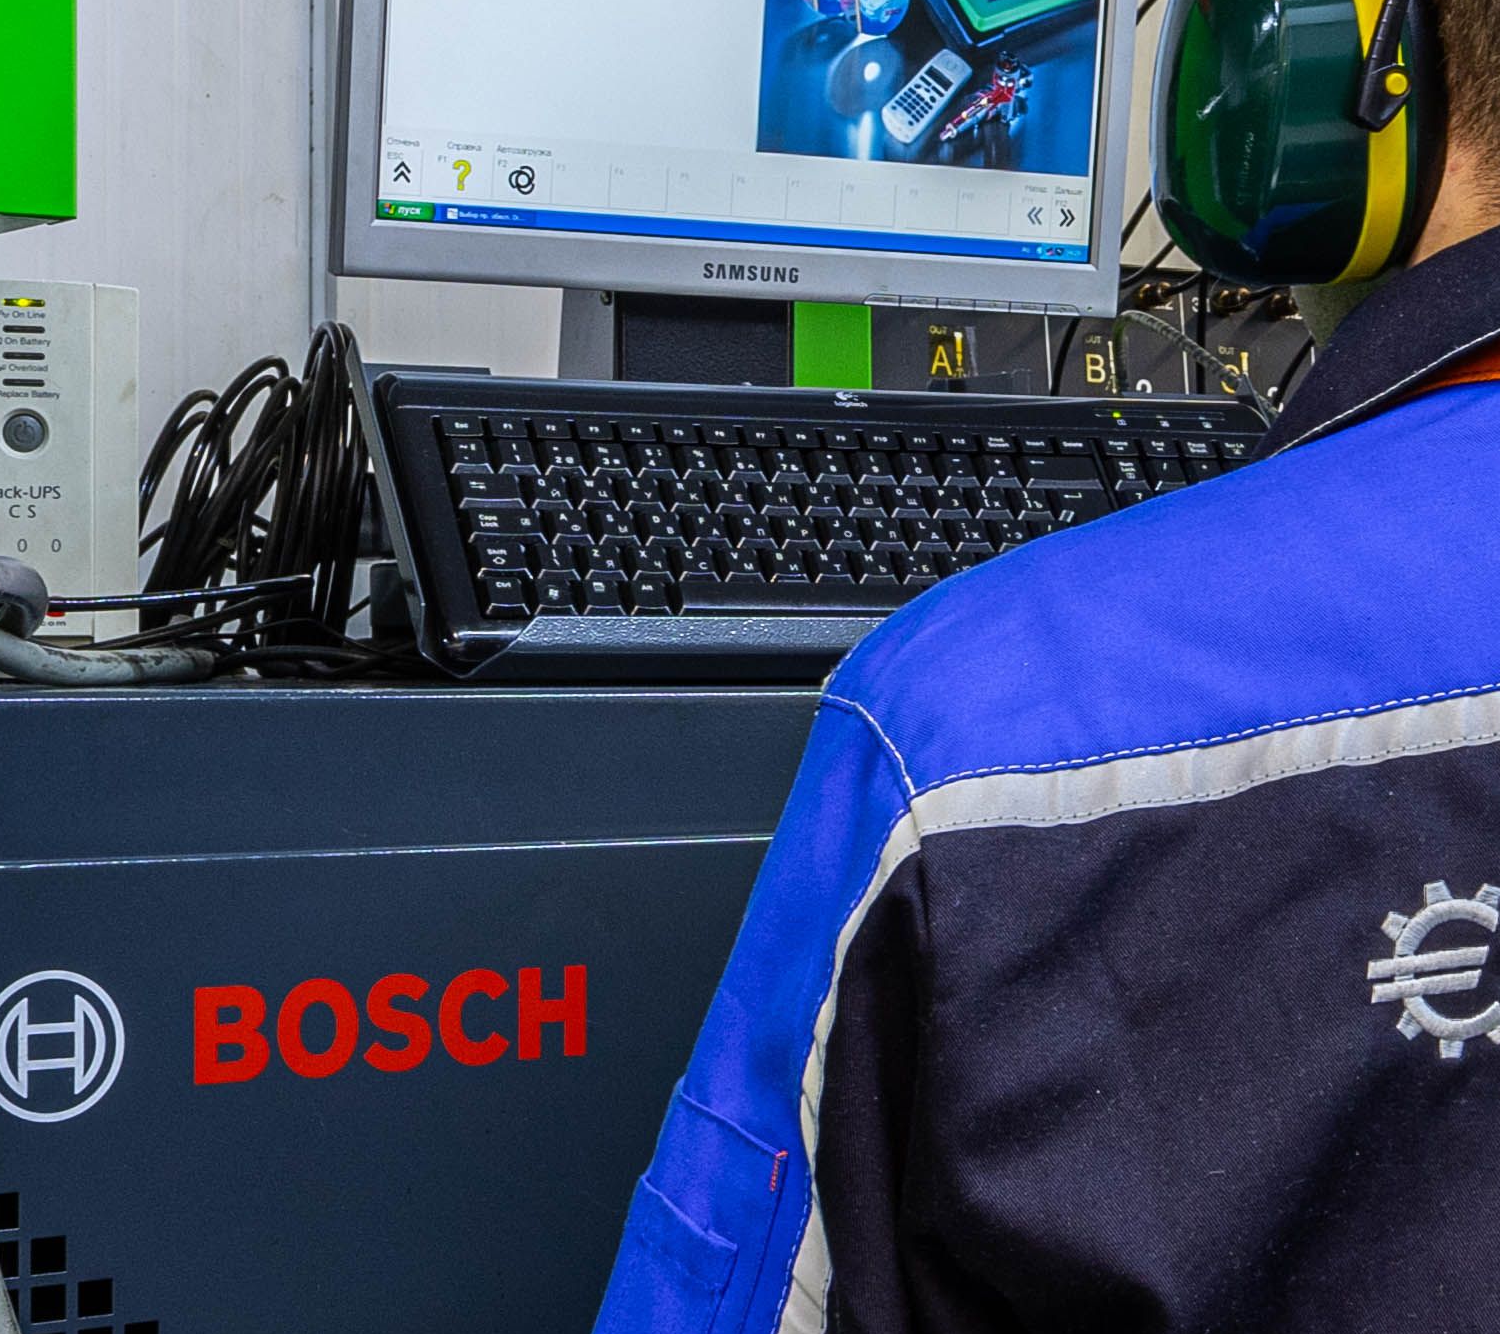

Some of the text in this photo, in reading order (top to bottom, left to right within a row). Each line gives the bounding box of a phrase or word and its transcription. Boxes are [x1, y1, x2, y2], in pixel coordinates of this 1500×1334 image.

[702, 263, 800, 284] SAMSUNG
[11, 310, 46, 319] On Line
[4, 336, 18, 346] On
[930, 345, 953, 376] A
[1085, 353, 1106, 384] B
[193, 964, 588, 1086] BOSCH
